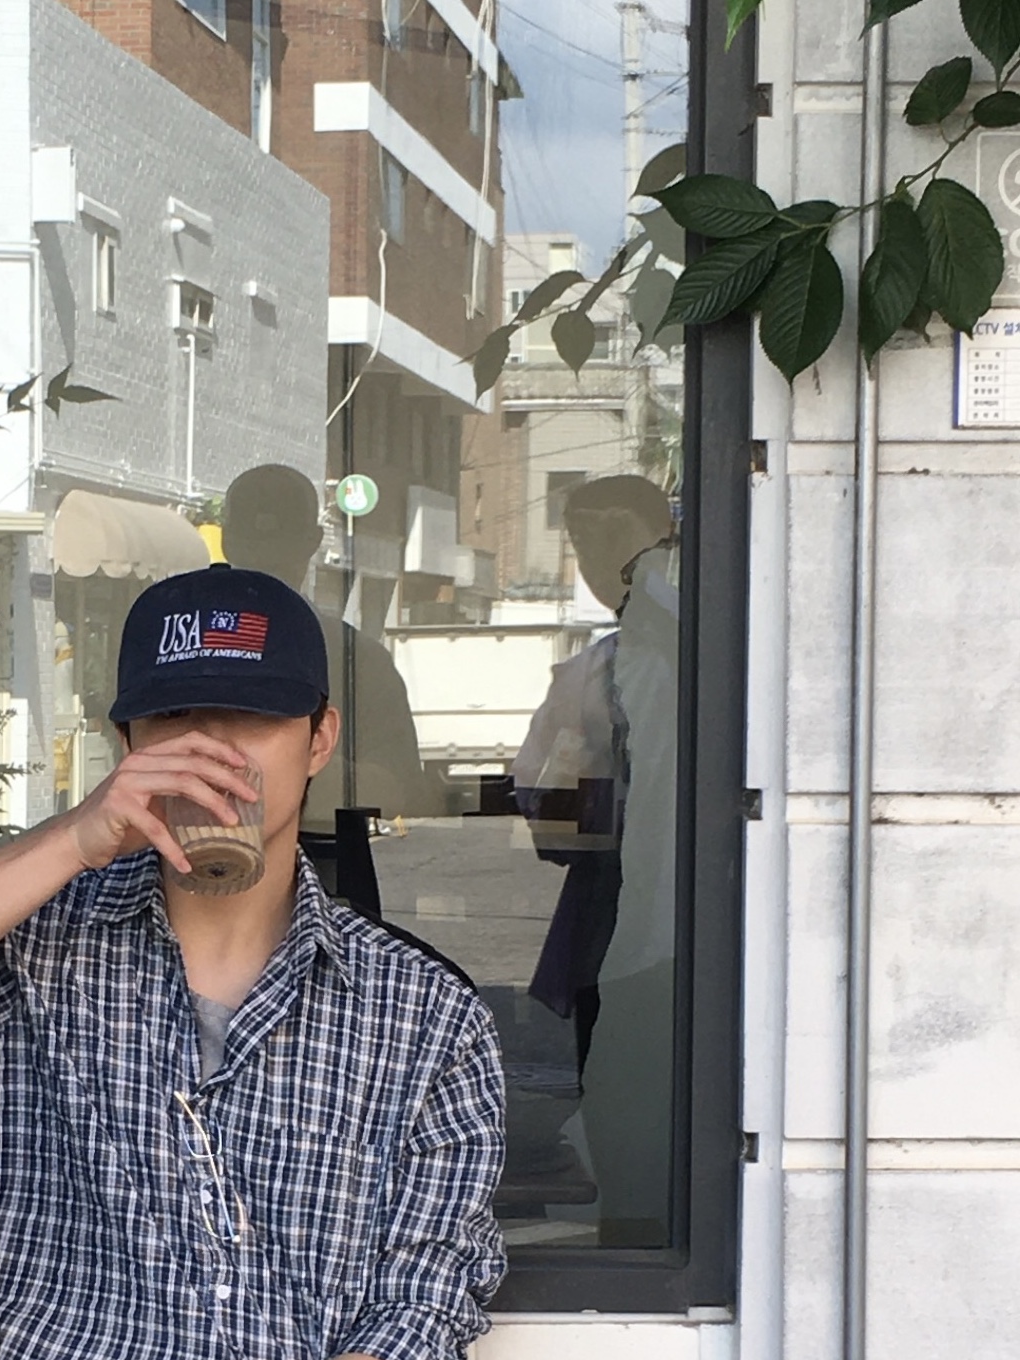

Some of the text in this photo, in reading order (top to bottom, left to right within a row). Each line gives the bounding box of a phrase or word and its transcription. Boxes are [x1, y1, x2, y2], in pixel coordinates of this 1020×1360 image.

[973, 322, 1000, 336] CTV
[159, 610, 202, 654] USA
[168, 650, 199, 663] AFRAID
[199, 648, 214, 658] OF
[212, 648, 263, 661] AMERICANS
